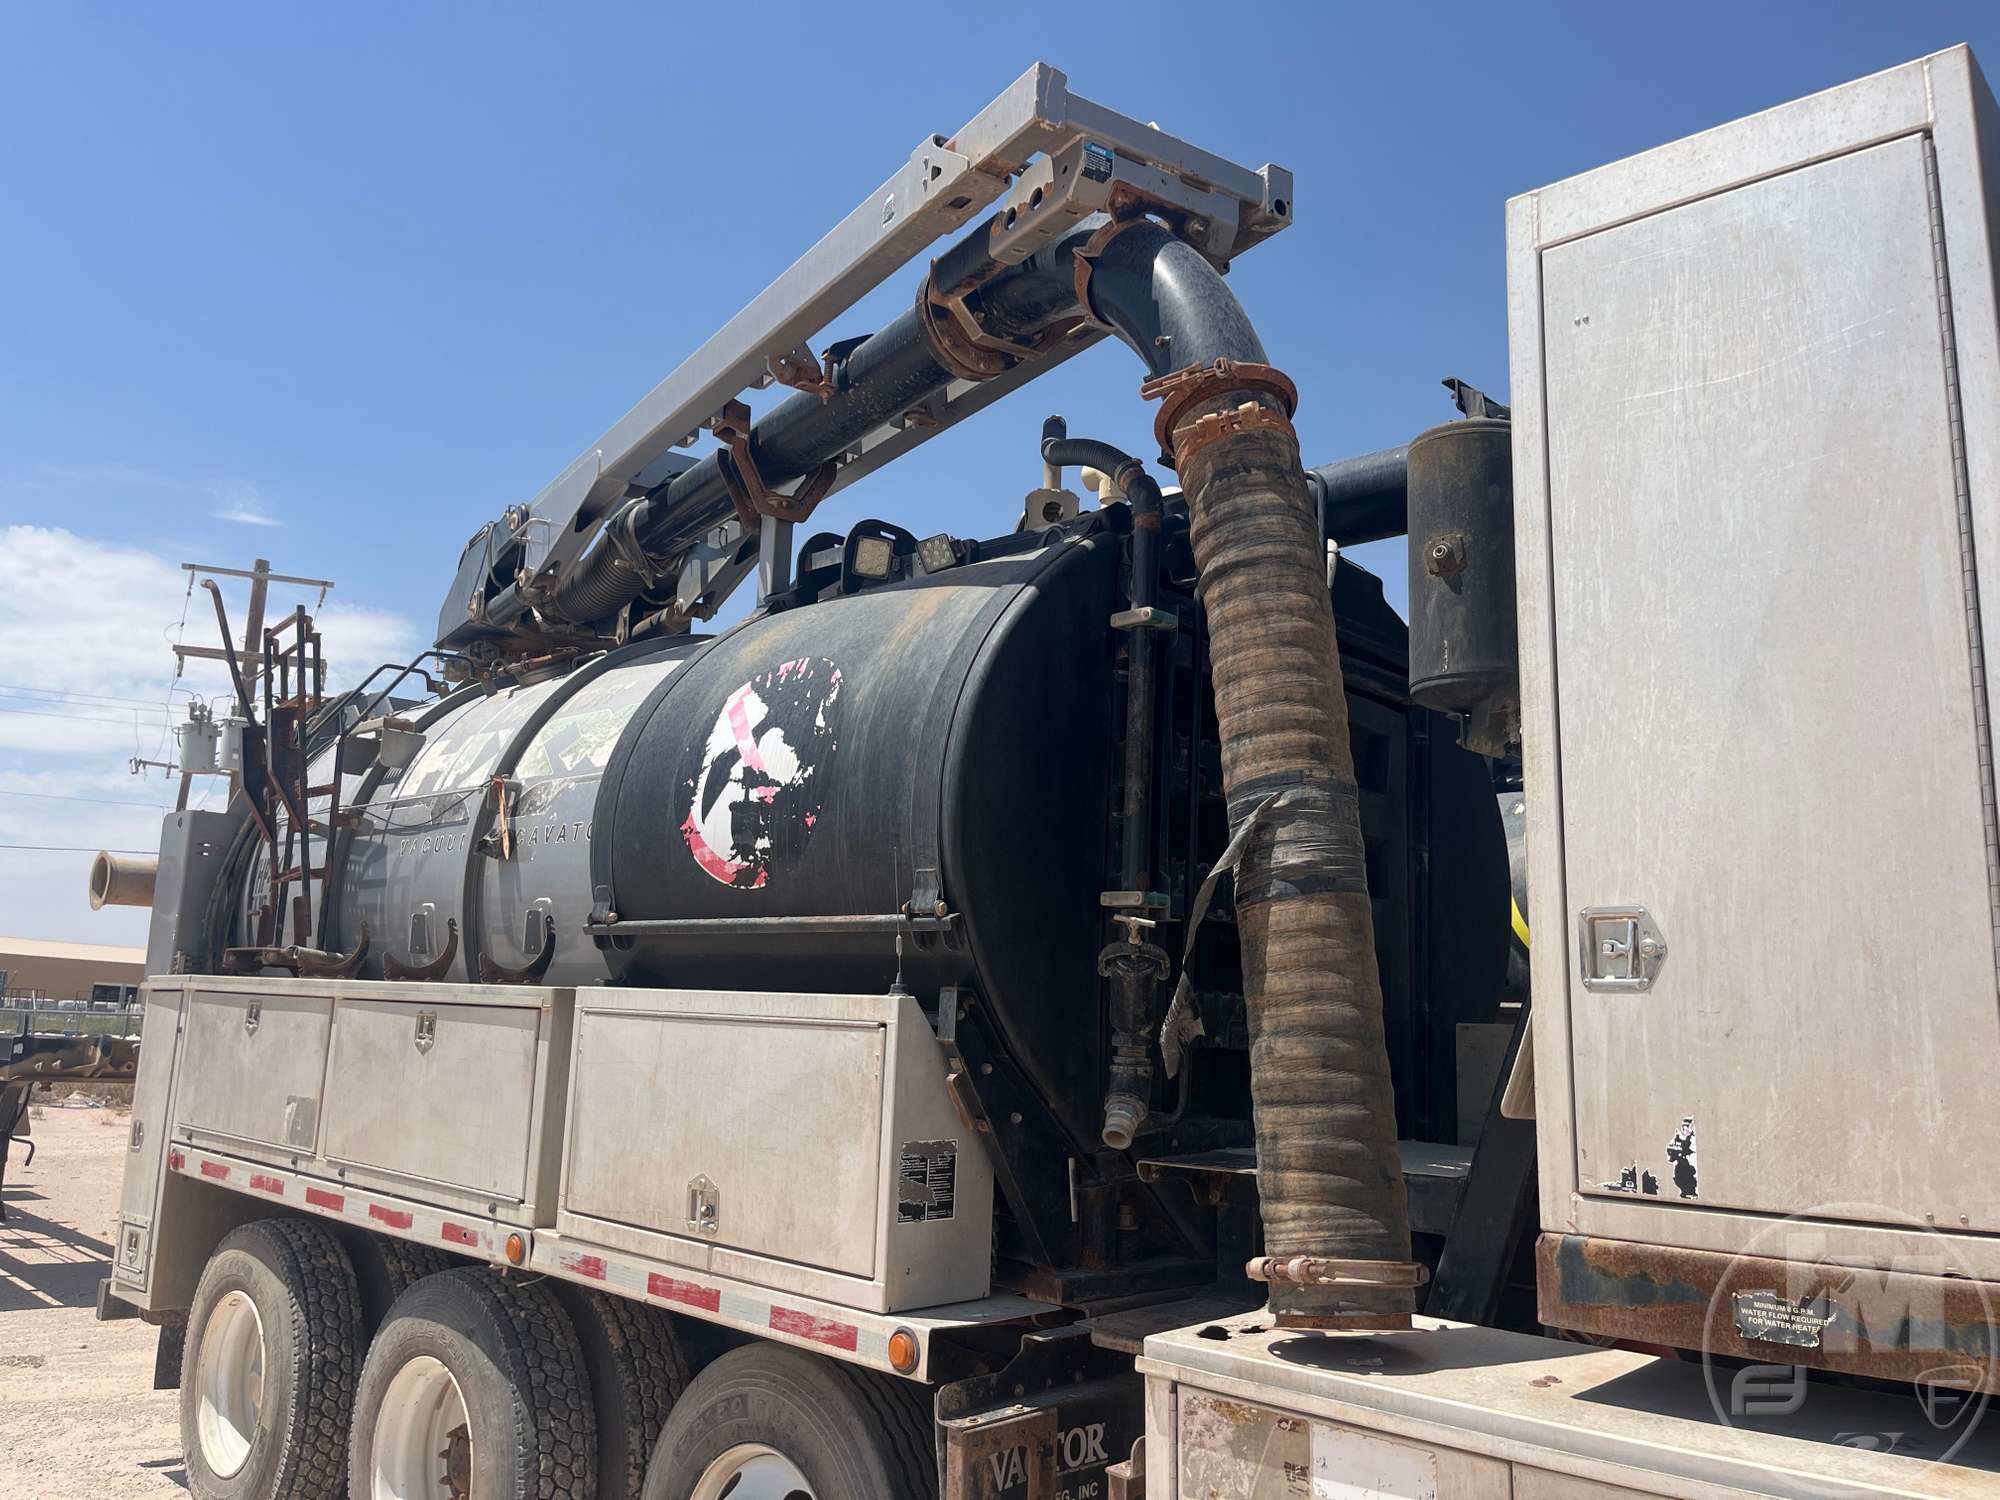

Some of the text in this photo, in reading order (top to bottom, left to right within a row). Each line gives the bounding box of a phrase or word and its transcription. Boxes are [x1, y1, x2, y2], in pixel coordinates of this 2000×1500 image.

[1741, 1307, 1829, 1326] WATER FLOW REQUIRED
[1748, 1316, 1764, 1325] FOR
[1764, 1318, 1791, 1329] WATER
